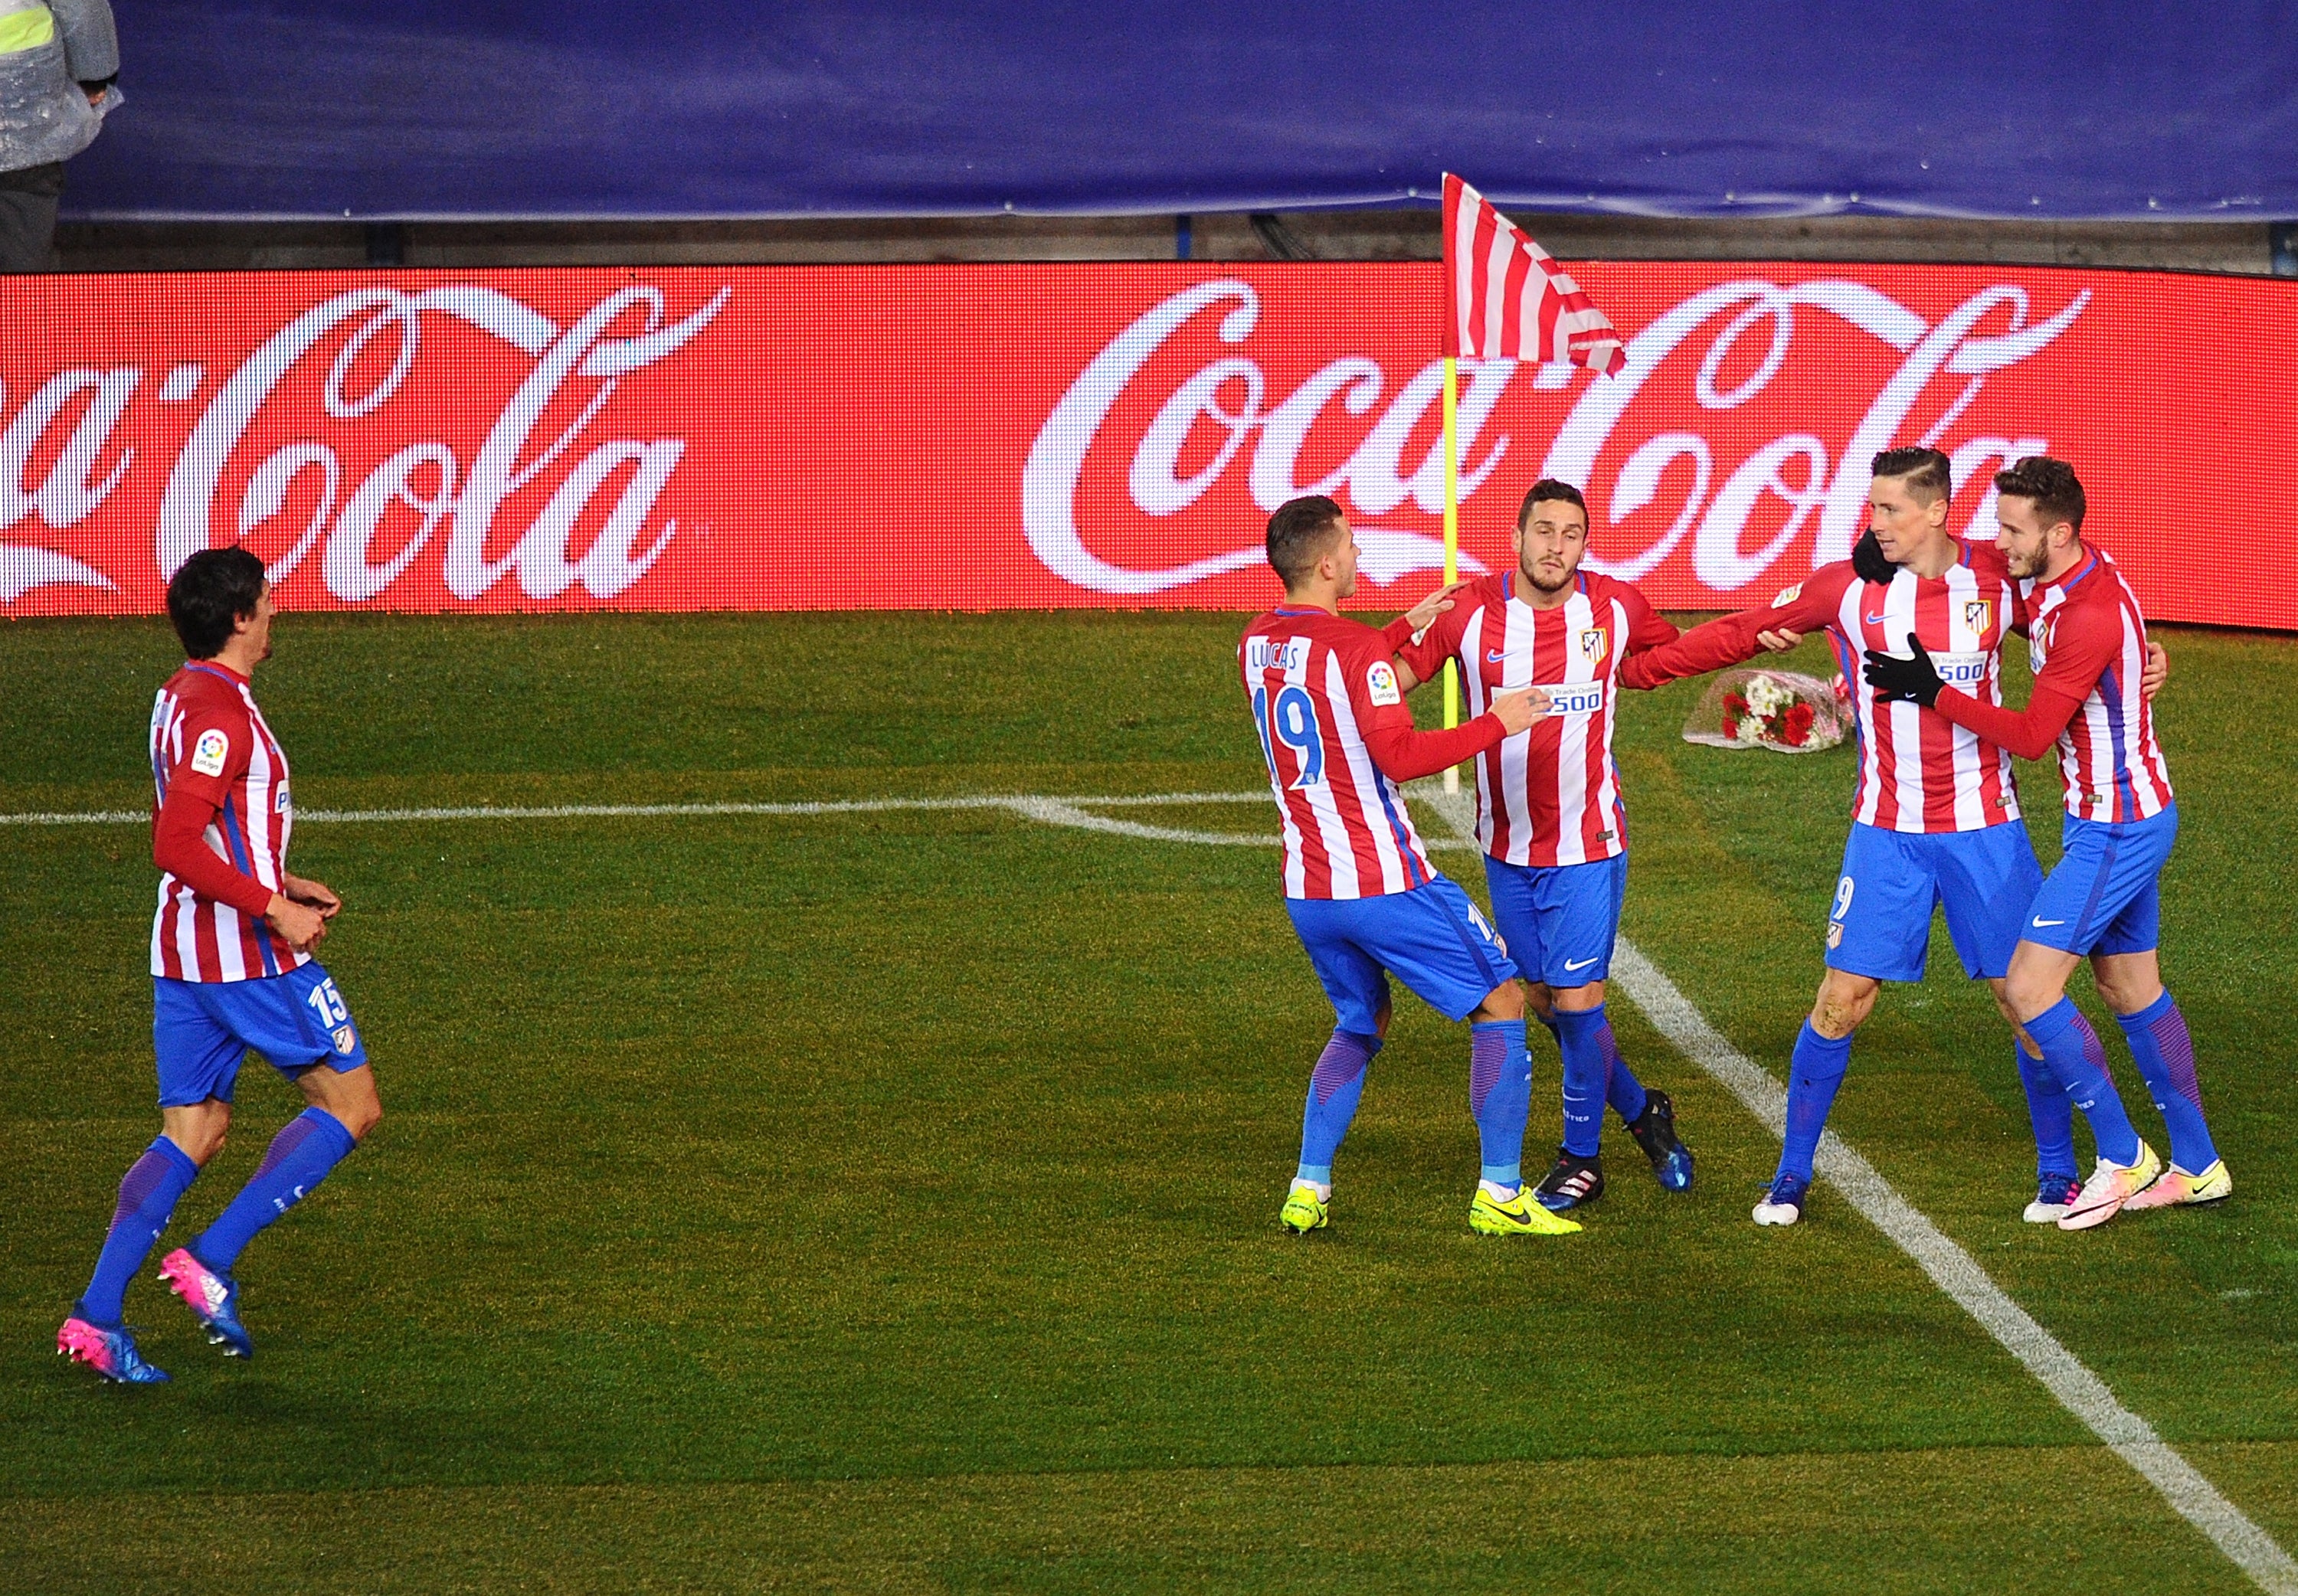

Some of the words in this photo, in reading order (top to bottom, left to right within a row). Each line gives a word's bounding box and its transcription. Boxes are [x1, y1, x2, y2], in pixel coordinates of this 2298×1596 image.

[0, 285, 732, 602] a-Cola
[1252, 643, 1298, 670] LUCAS
[1544, 693, 1599, 712] 500
[1252, 685, 1324, 790] 19
[1833, 875, 1855, 920] 9
[1468, 902, 1494, 941] 1
[308, 976, 347, 1029] 15
